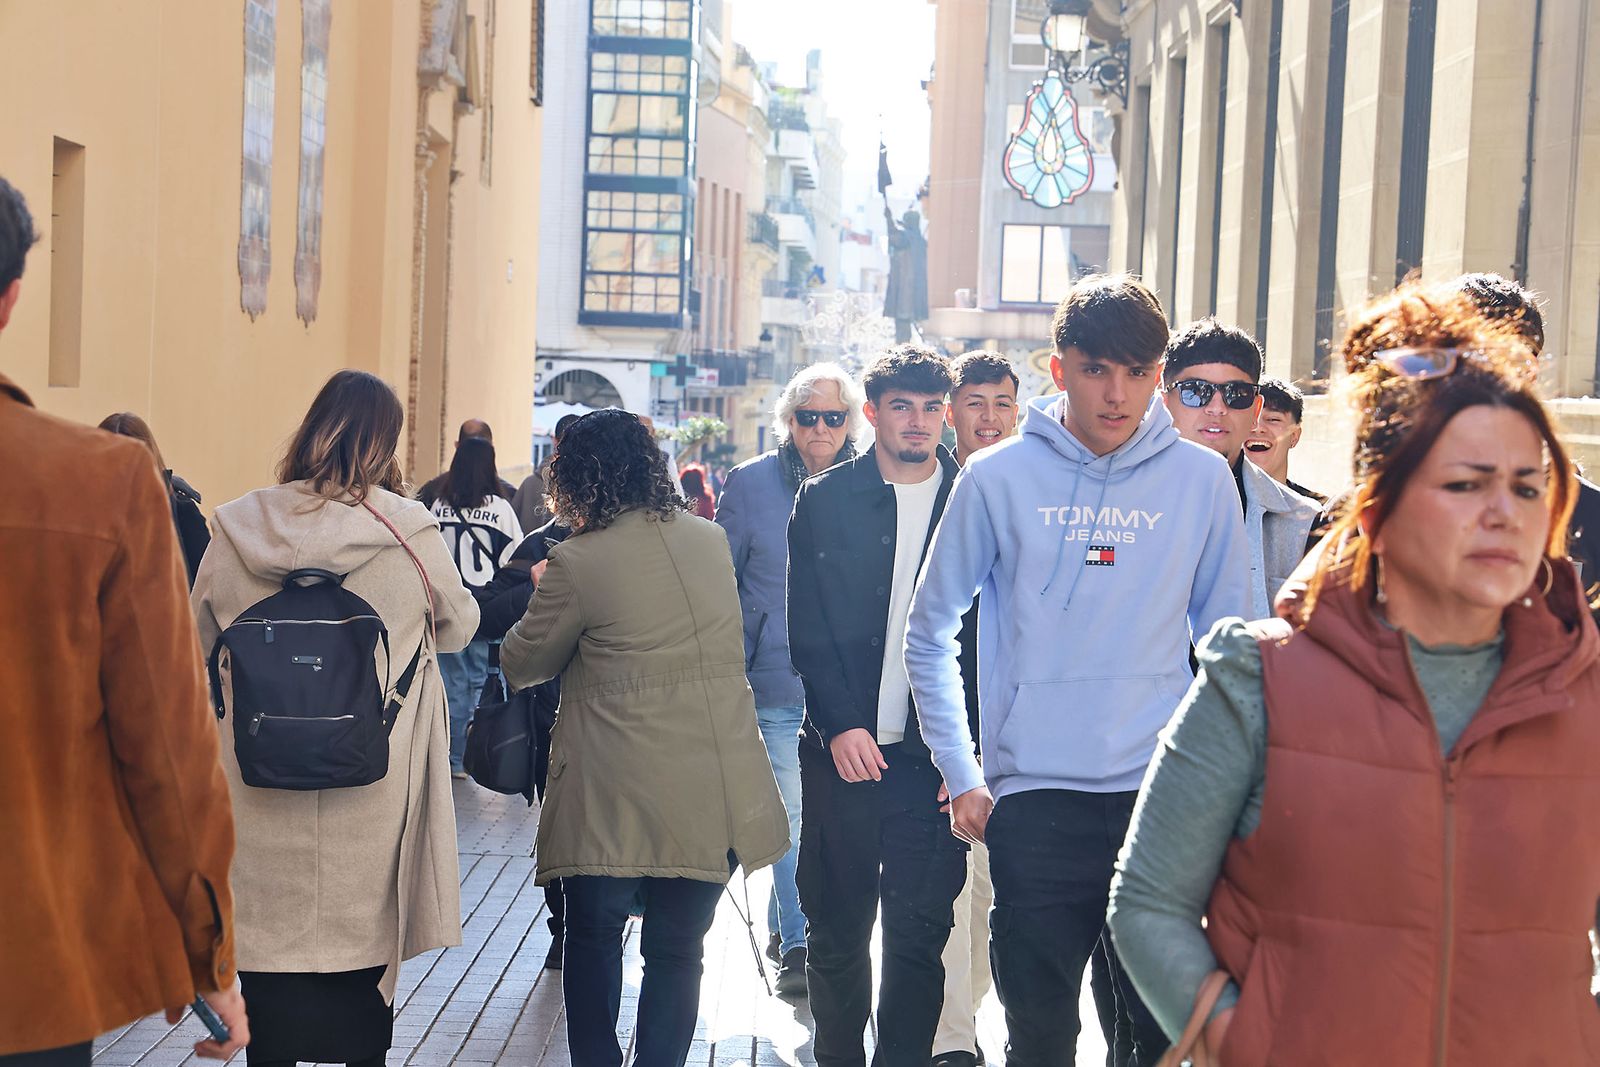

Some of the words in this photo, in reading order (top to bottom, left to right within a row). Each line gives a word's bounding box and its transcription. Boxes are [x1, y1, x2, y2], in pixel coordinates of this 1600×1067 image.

[467, 508, 500, 524] YORK
[1037, 506, 1164, 530] TOMMY
[1065, 529, 1136, 544] JEANS
